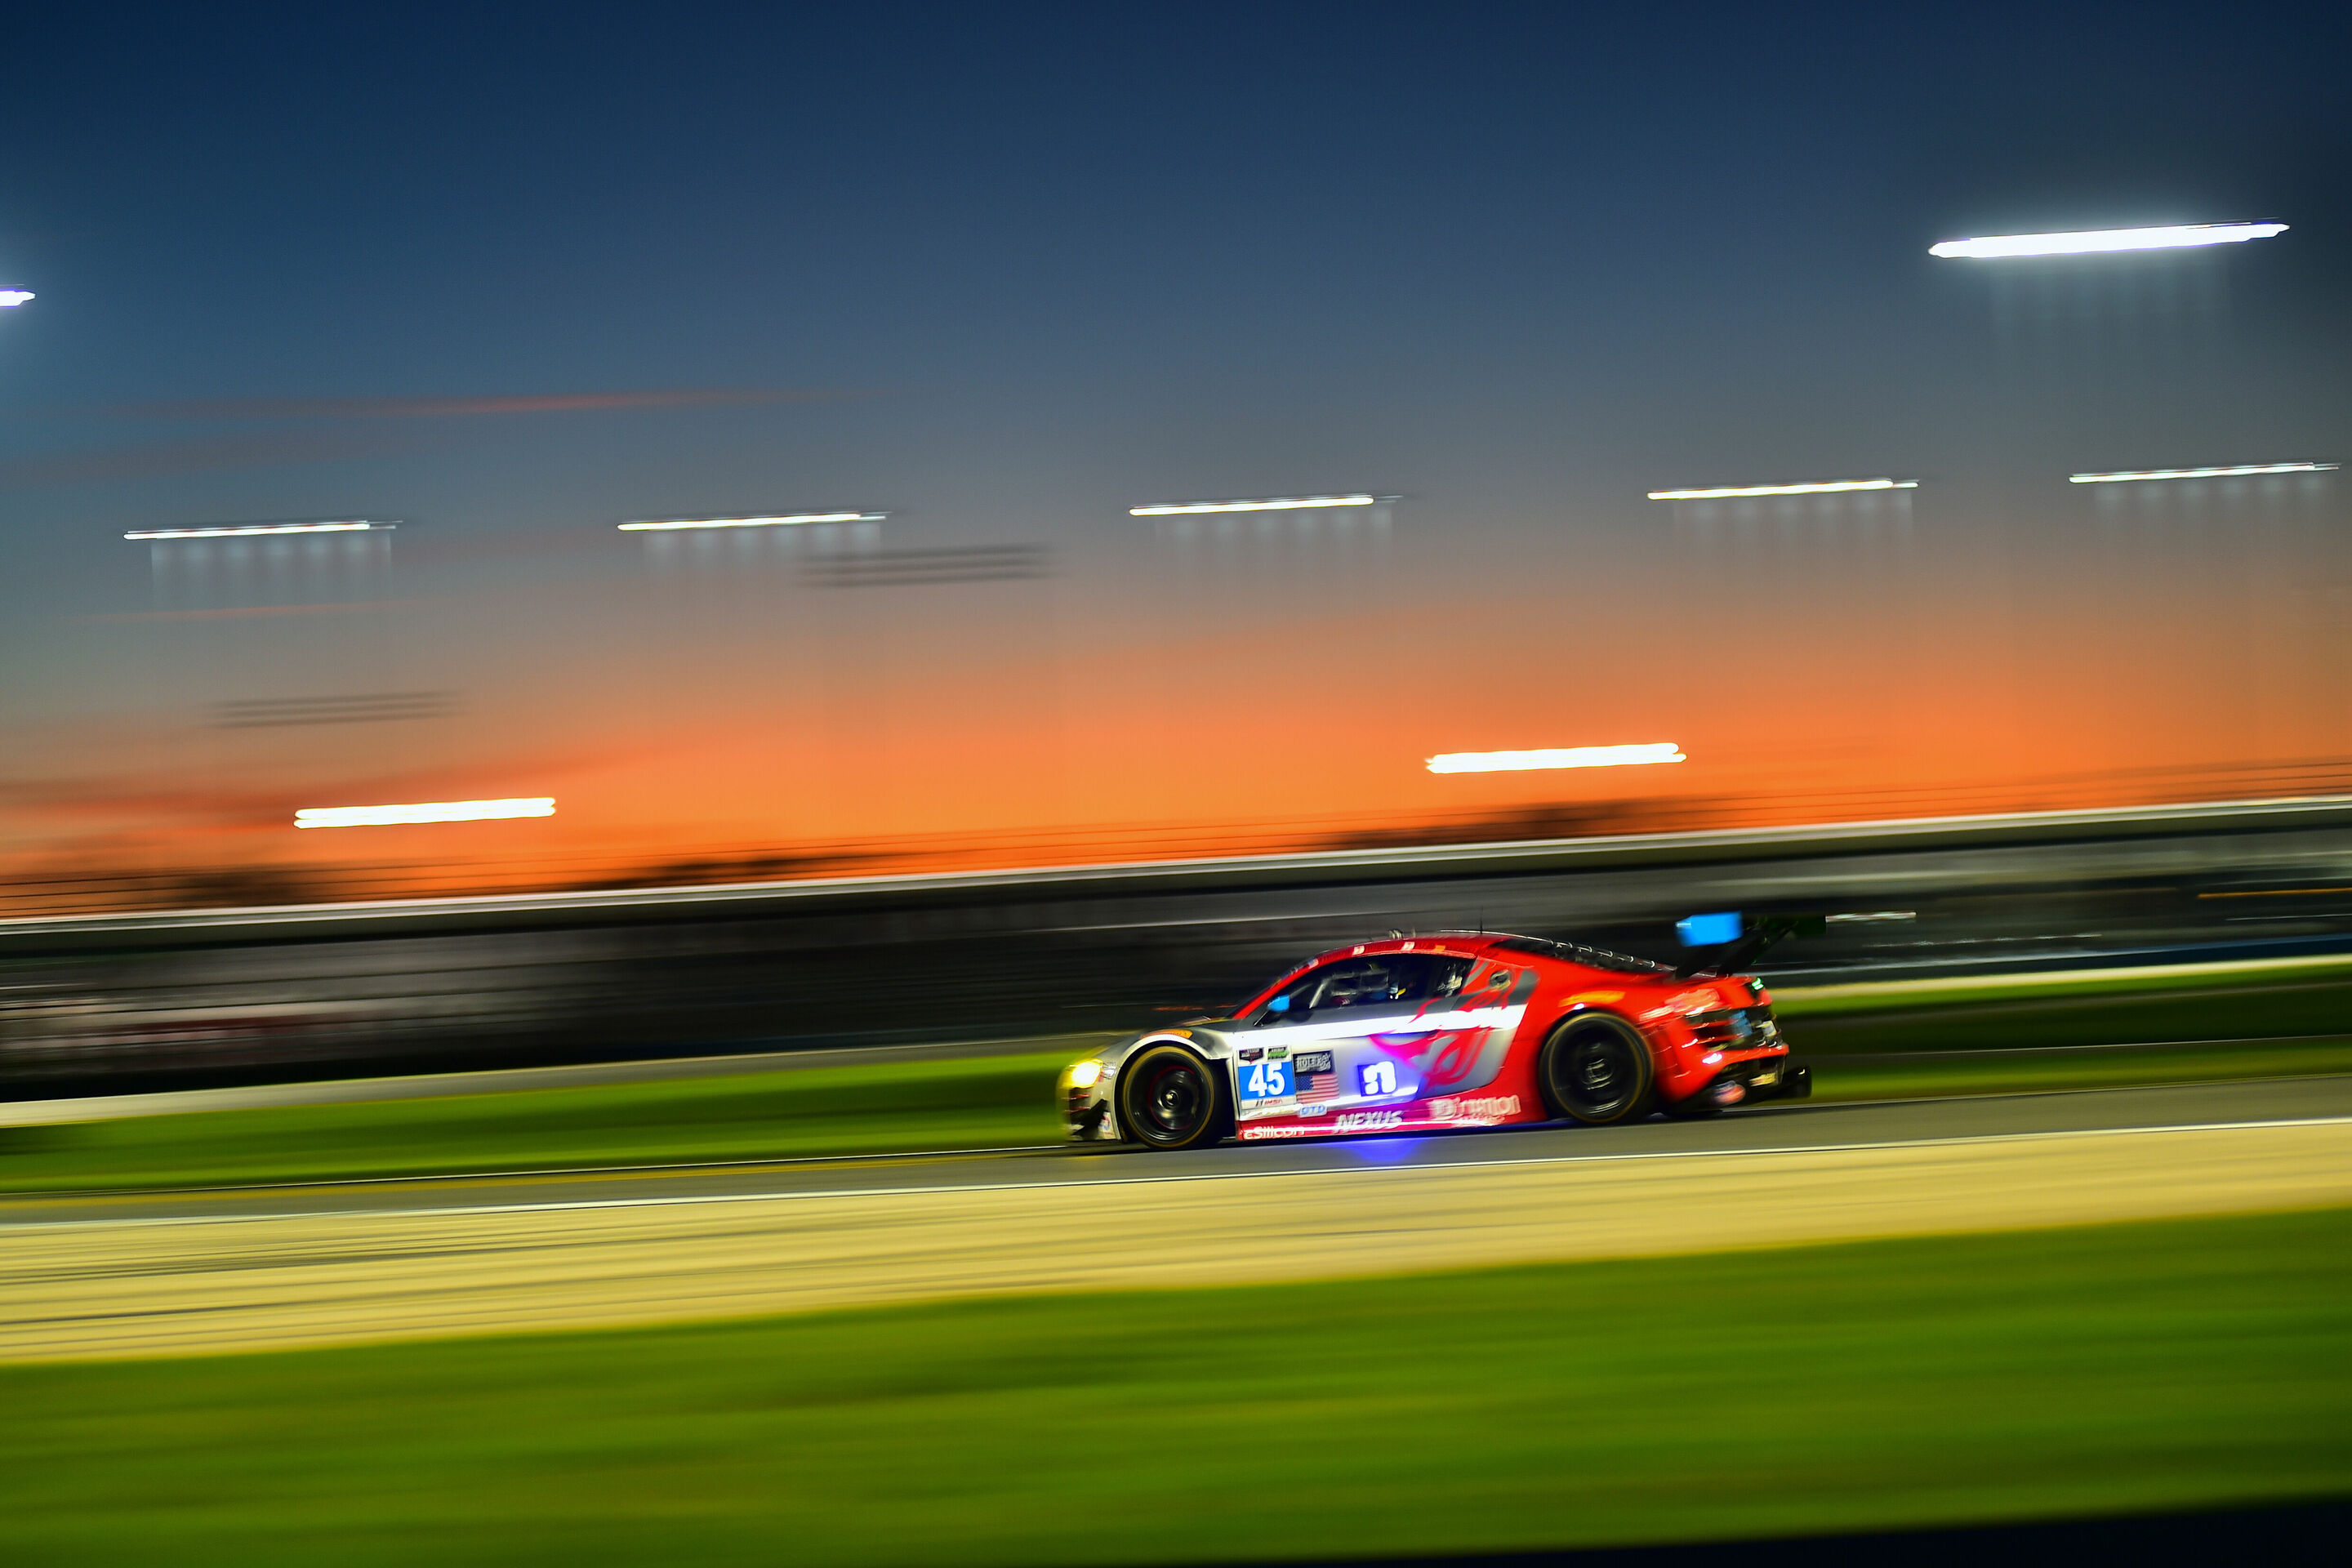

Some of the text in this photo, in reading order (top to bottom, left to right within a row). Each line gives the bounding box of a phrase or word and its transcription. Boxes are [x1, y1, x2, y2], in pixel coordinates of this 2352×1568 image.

[1248, 1062, 1285, 1097] 45
[1243, 1125, 1306, 1139] eSilicon
[1336, 1111, 1404, 1134] NEXUS
